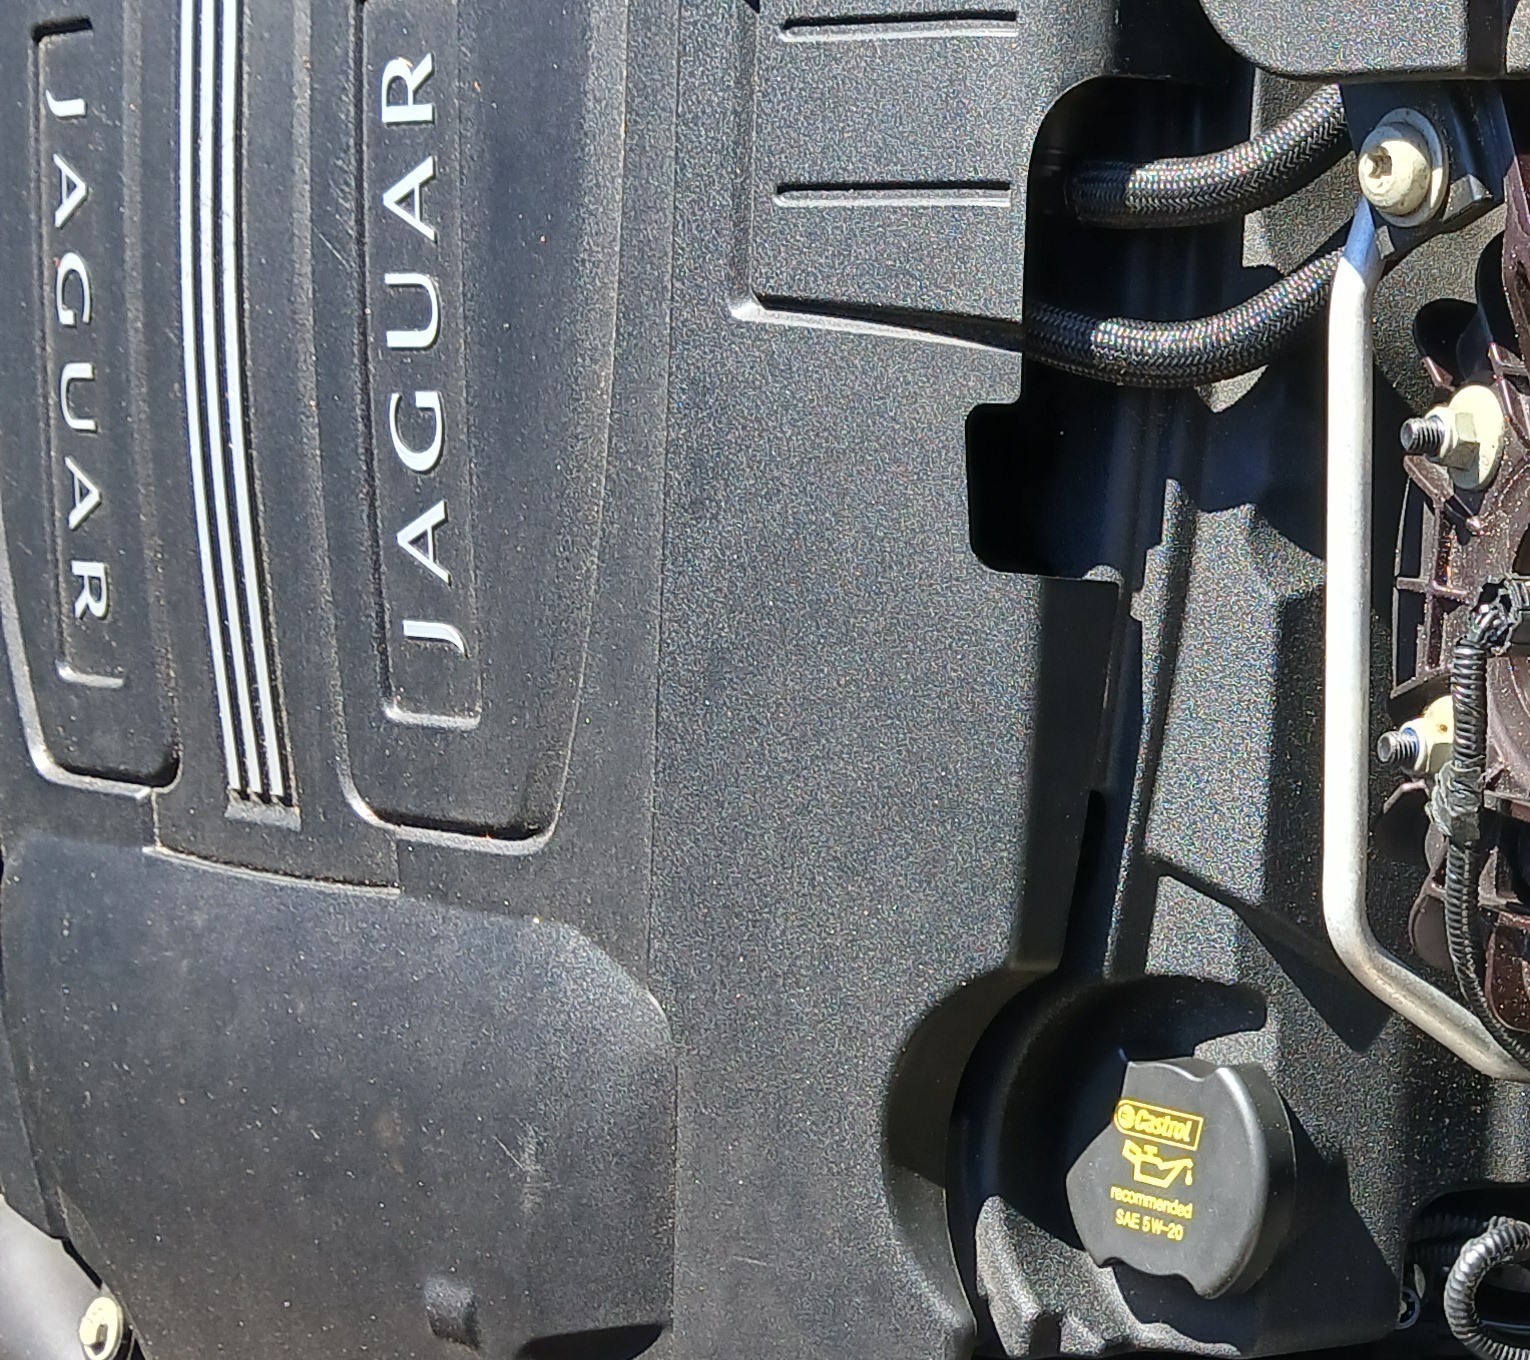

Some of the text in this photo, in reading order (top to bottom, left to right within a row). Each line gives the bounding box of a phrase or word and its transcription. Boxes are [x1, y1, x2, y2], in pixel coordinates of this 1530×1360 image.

[45, 90, 109, 621] JAGUAR
[380, 52, 469, 657] JAGUAR
[1134, 1109, 1192, 1141] Castrol
[1110, 1186, 1193, 1219] recommended
[1115, 1209, 1184, 1240] SAE 5W-20
